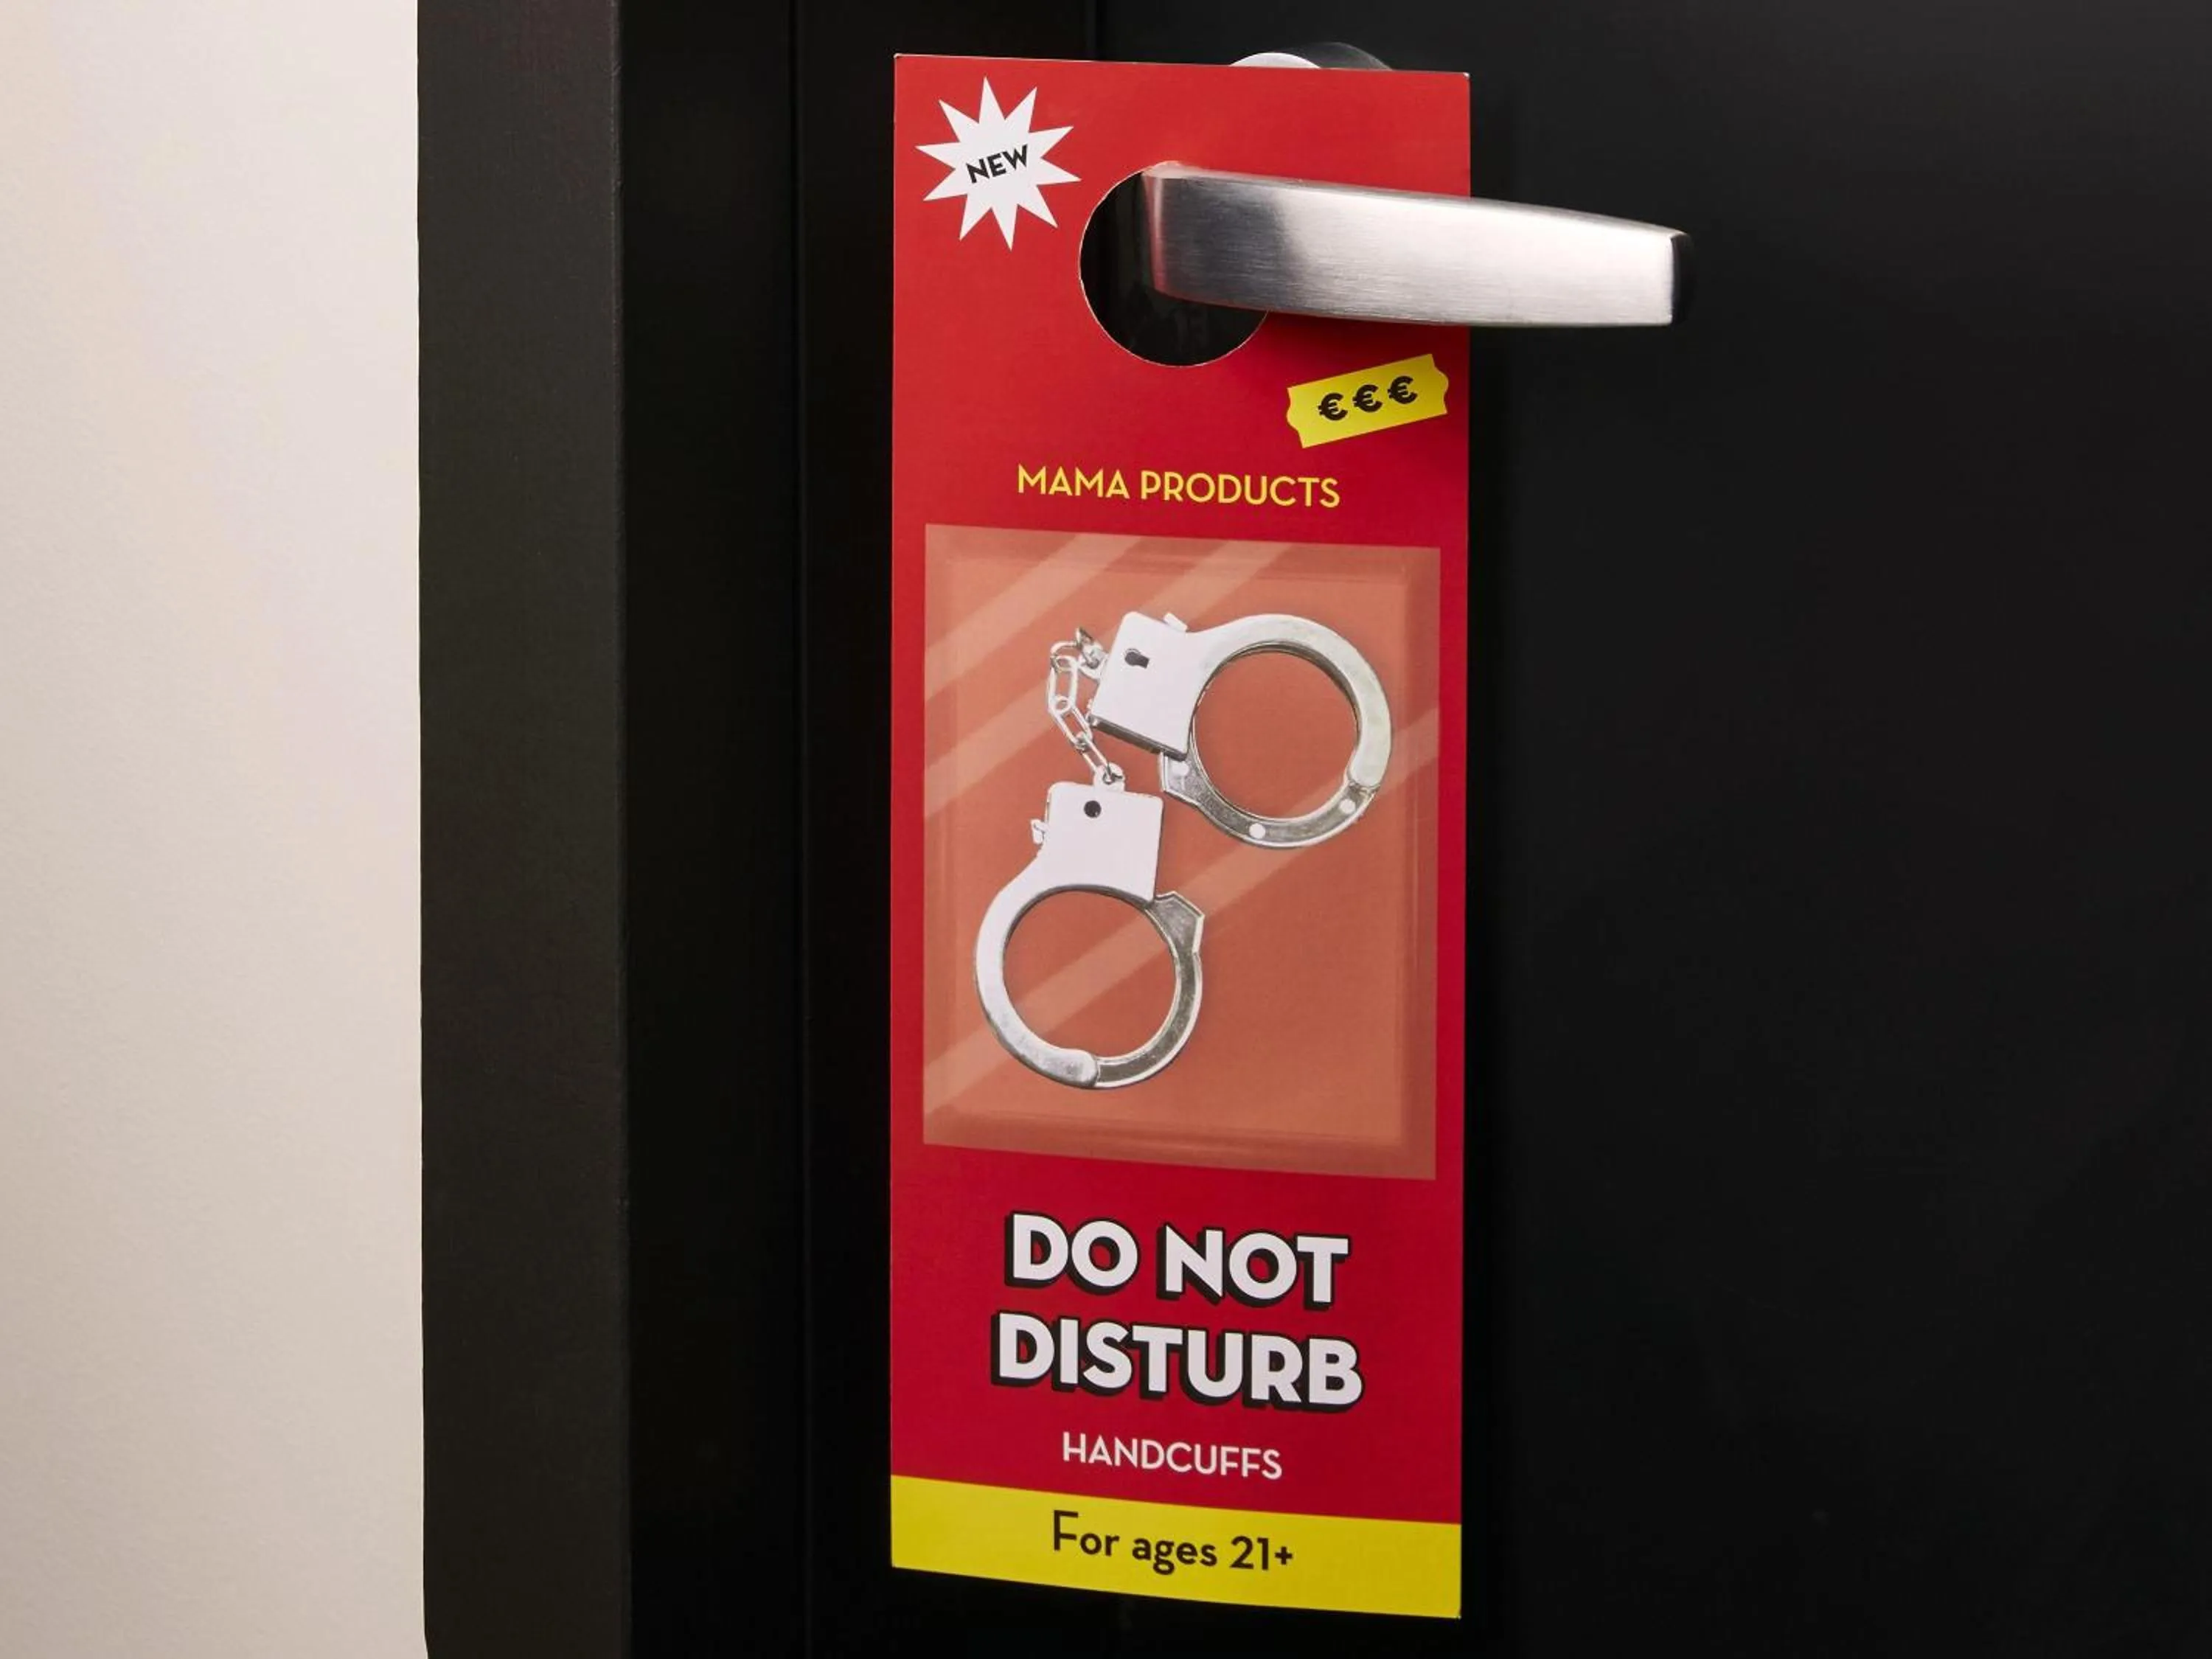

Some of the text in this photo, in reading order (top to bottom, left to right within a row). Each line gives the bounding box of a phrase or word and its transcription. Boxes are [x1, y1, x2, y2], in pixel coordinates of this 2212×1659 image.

[966, 144, 1029, 184] NEW
[1017, 464, 1340, 509] MAMA PRODUCTS
[1005, 1211, 1351, 1309] DO NOT
[991, 1310, 1364, 1411] DISTURB
[1062, 1430, 1283, 1481] HANDCUFFS
[1053, 1510, 1293, 1575] For ages 21+
